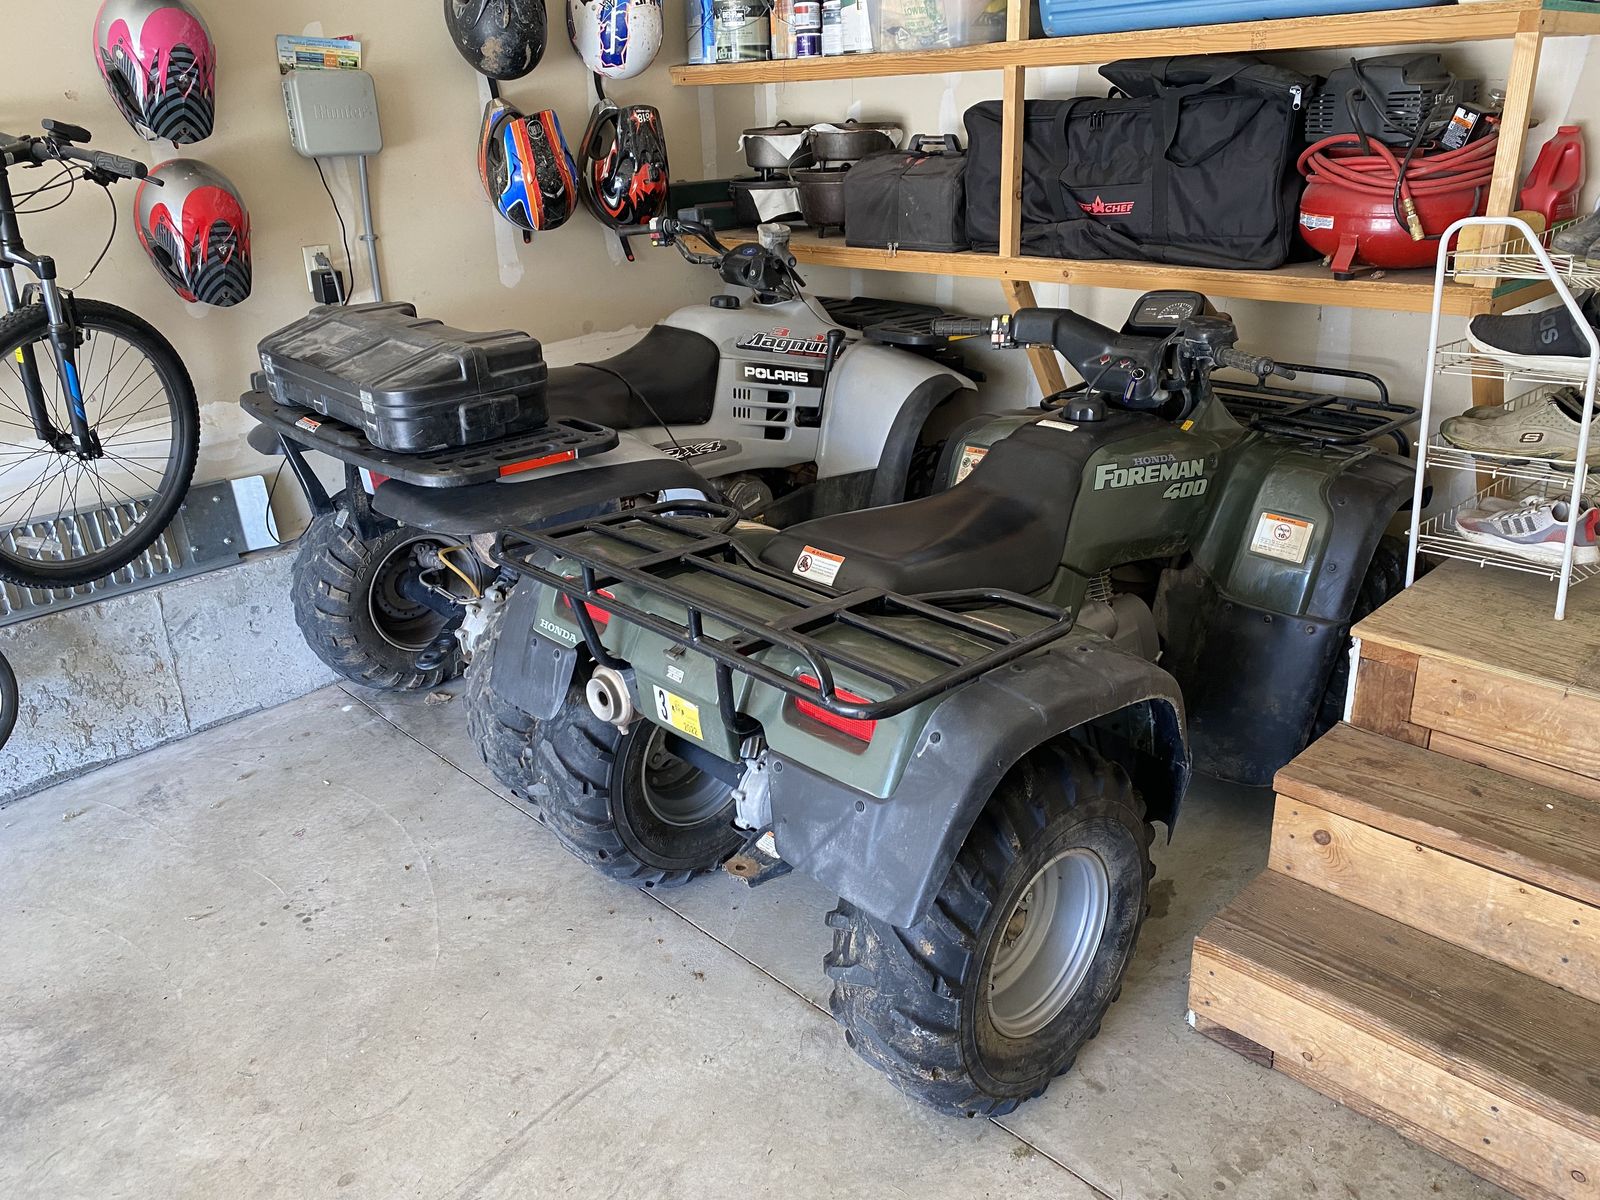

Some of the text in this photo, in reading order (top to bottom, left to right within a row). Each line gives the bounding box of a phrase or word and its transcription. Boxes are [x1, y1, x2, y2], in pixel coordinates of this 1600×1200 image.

[1105, 203, 1134, 213] CHEF
[744, 366, 809, 383] POLARIS
[1134, 453, 1177, 466] HONDA
[1162, 479, 1208, 500] 400
[540, 618, 577, 644] HONDA
[659, 689, 668, 721] 3
